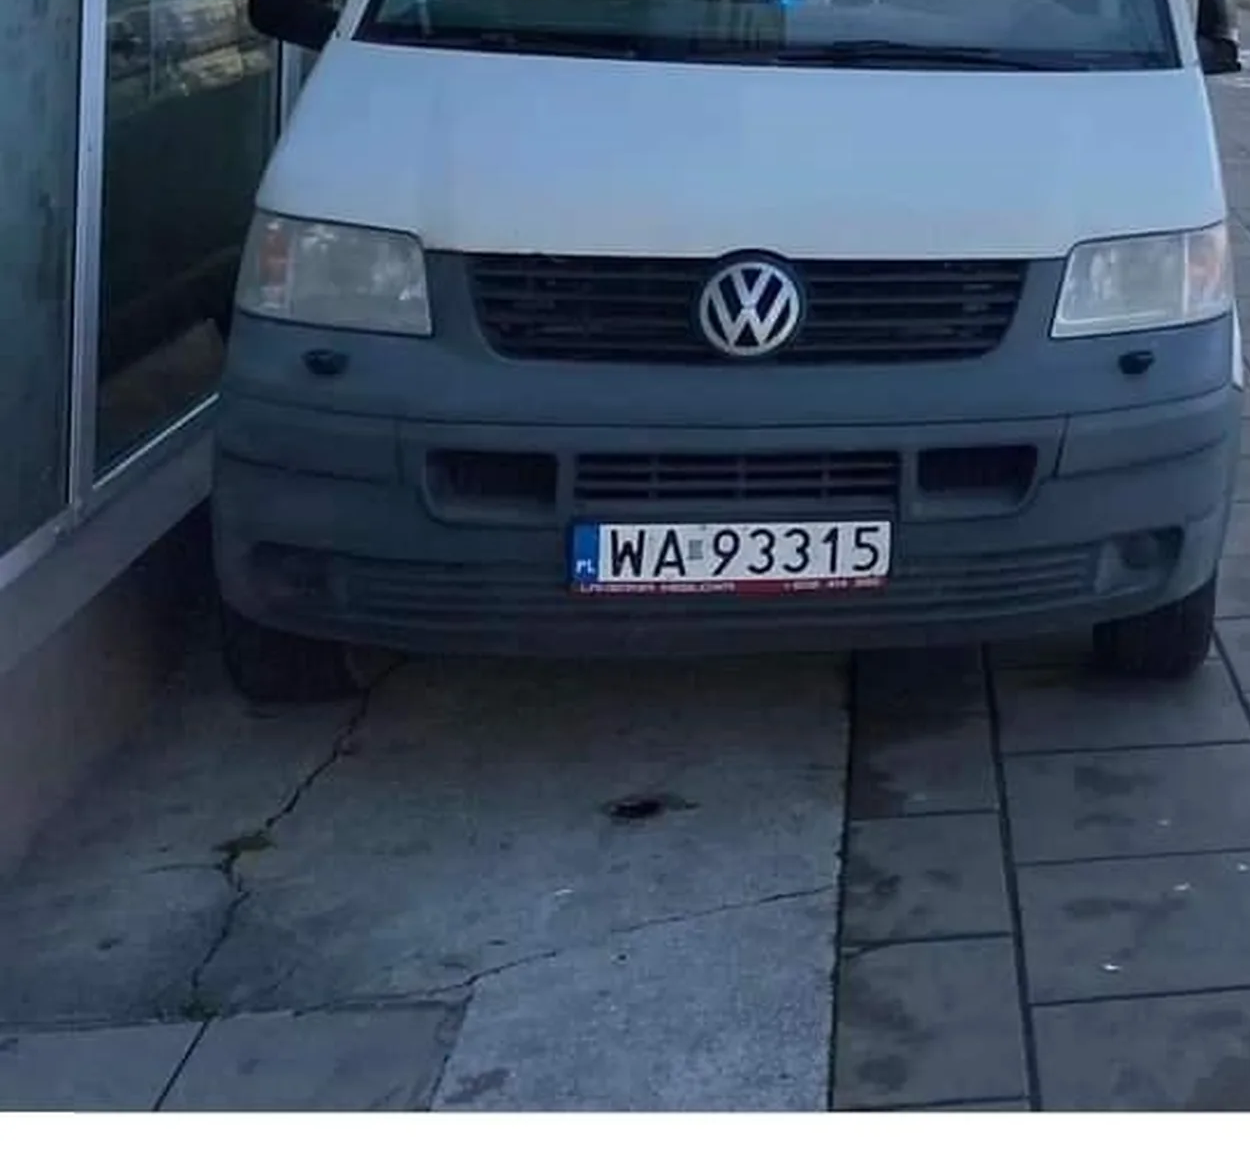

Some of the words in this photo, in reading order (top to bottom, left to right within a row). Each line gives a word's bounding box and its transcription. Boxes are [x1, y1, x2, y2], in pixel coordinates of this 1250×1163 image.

[699, 261, 800, 357] VW
[610, 528, 687, 577] WA
[712, 525, 881, 577] 93315
